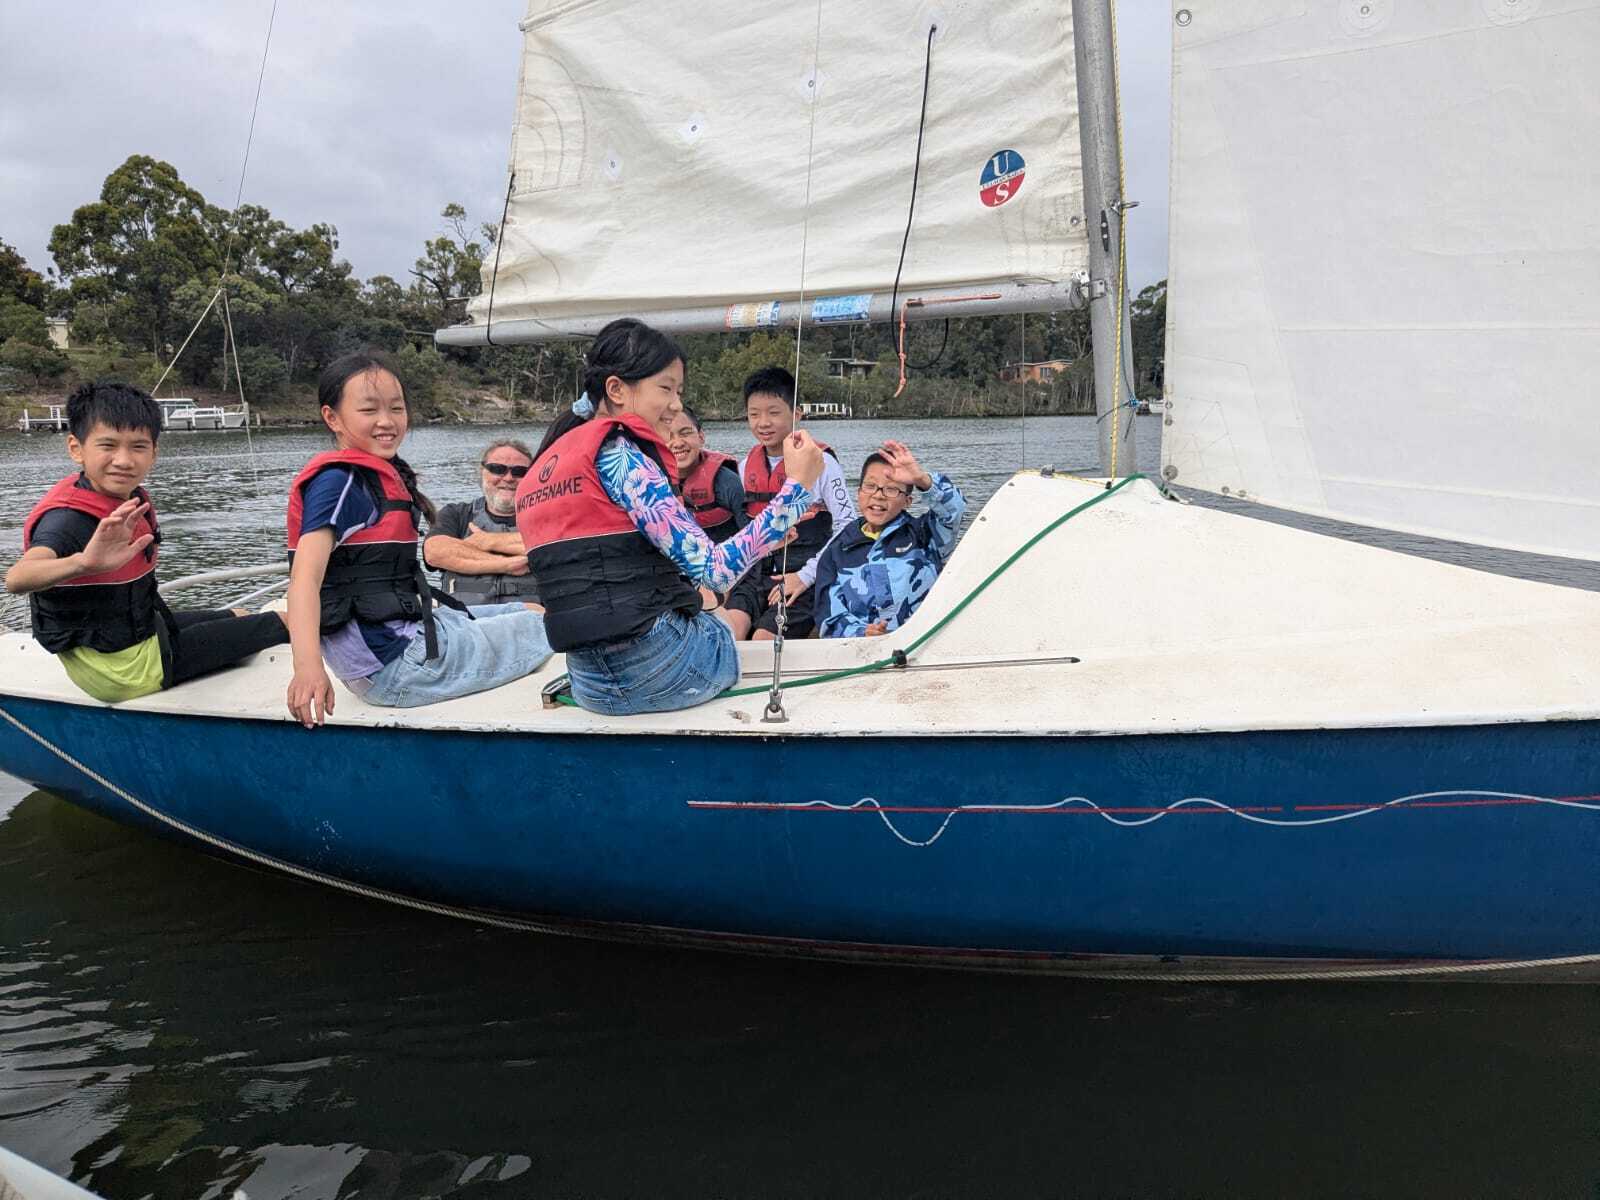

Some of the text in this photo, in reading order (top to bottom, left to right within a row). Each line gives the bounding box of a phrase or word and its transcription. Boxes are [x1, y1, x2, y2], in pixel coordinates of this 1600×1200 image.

[992, 151, 1009, 176] U
[993, 181, 1010, 205] S
[831, 477, 855, 520] ROXY
